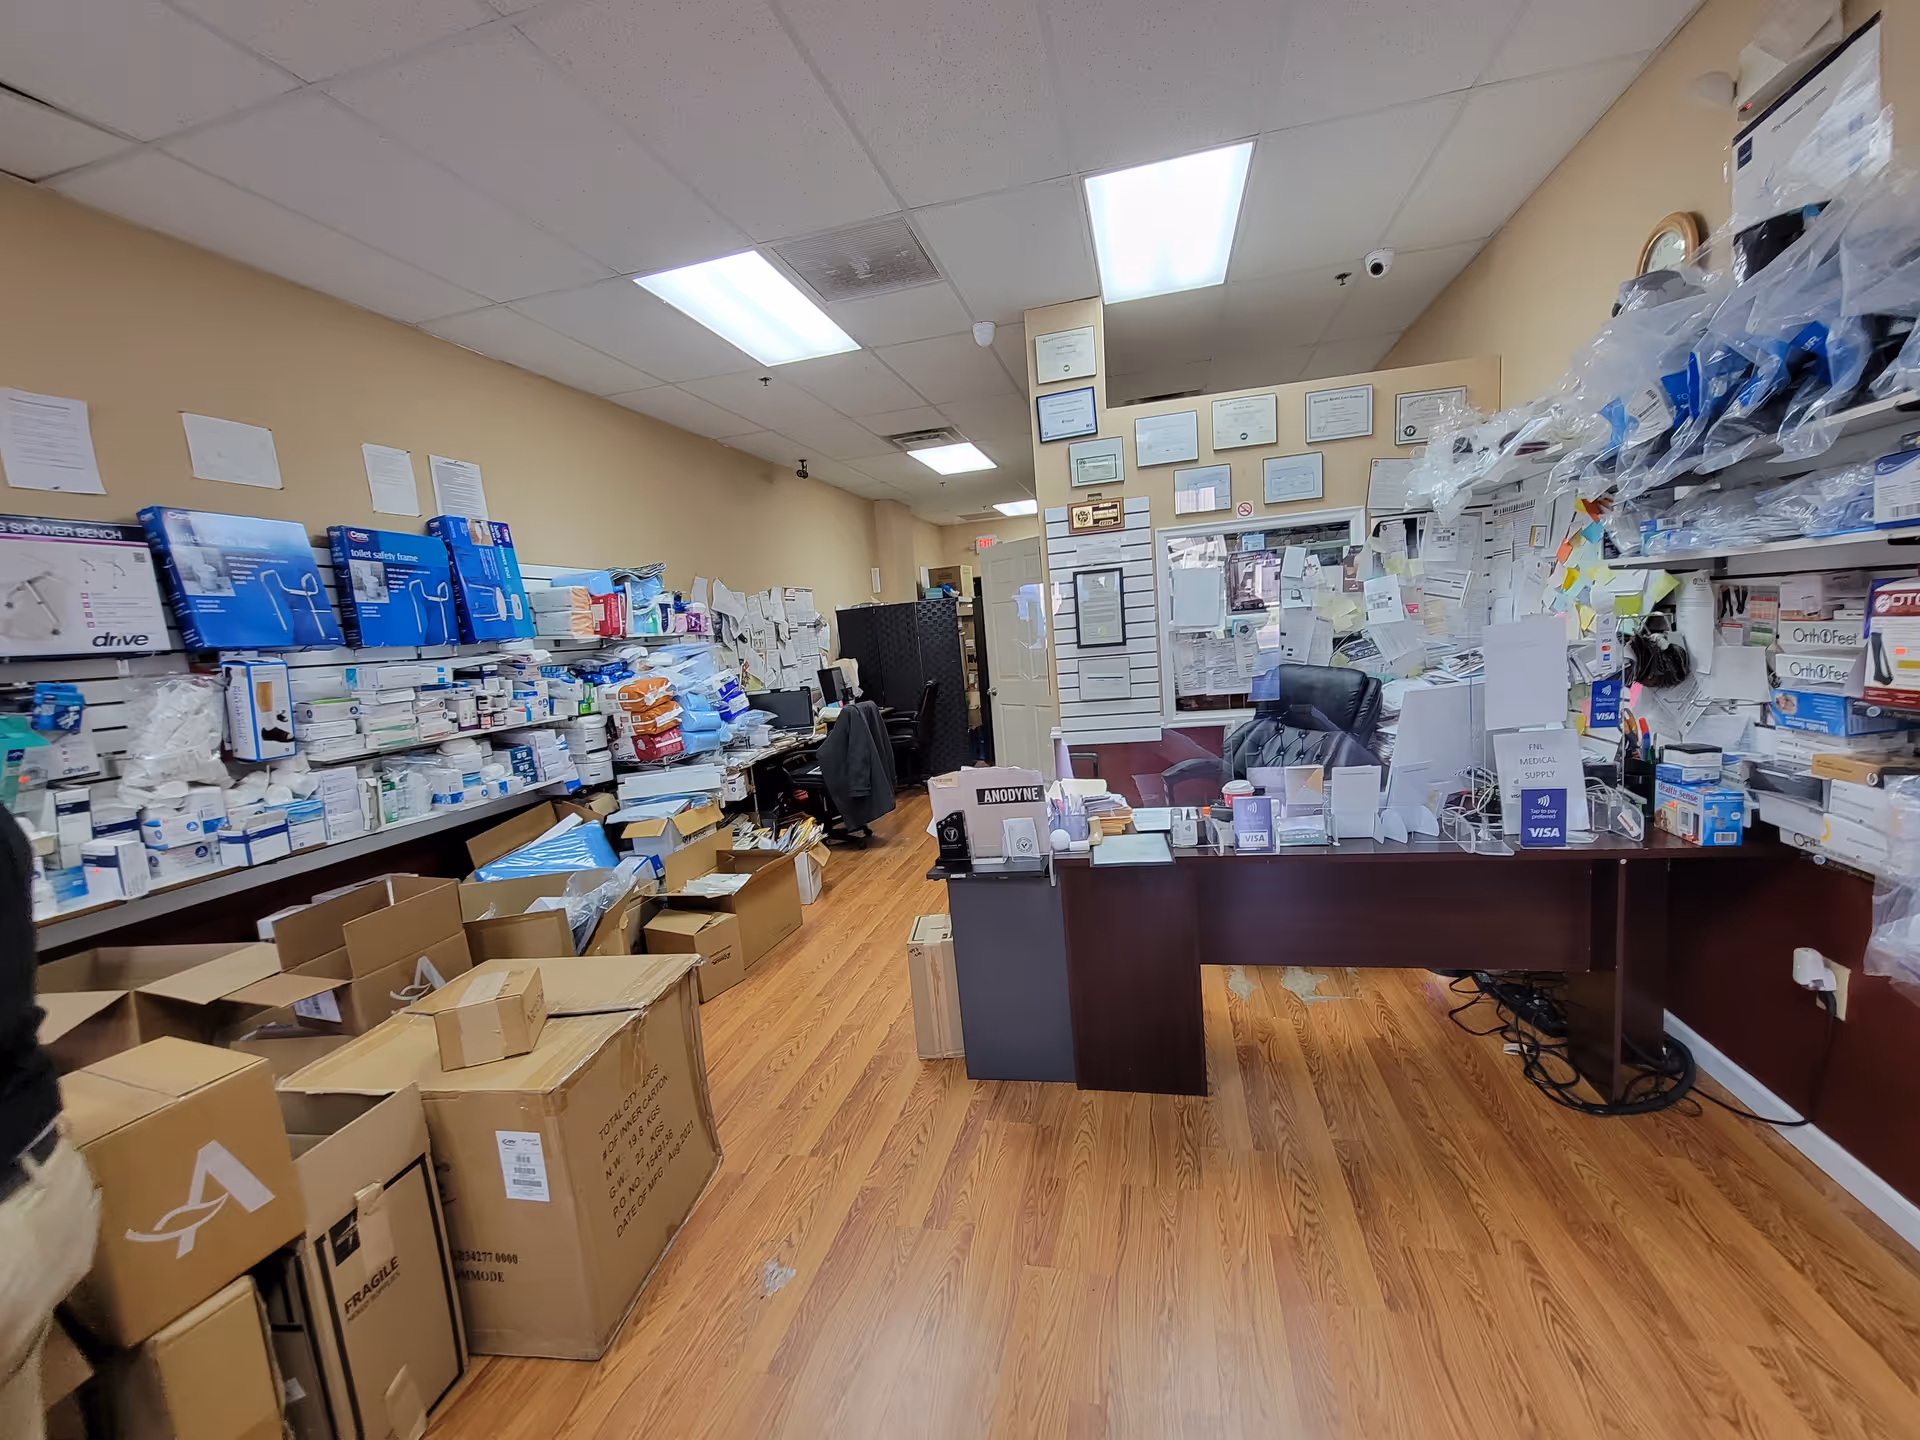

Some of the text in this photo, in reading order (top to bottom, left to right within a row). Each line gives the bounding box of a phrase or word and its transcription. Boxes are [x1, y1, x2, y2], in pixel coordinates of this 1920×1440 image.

[10, 523, 76, 537] SHOWER
[75, 527, 122, 540] BENCH
[978, 538, 993, 548] EXIT
[350, 549, 419, 563] toilet safety frame
[92, 631, 149, 647] drive
[1594, 712, 1616, 721] VISA
[1528, 743, 1545, 751] FNL
[1519, 756, 1557, 766] MEDICAL
[1524, 770, 1556, 780] SUPPLY
[984, 787, 1040, 803] ANODYNE
[1658, 782, 1678, 796] Health
[1679, 790, 1698, 803] Sense
[1244, 834, 1265, 842] VISA
[1528, 827, 1560, 838] VISA
[647, 1104, 661, 1127] KGS
[599, 1109, 623, 1141] TOTAL
[607, 1134, 619, 1154] OF
[620, 1105, 643, 1139] INNER
[635, 1147, 645, 1166] 22
[650, 1120, 665, 1144] KGS
[617, 1203, 638, 1238] DATE
[637, 1187, 648, 1207] OF
[648, 1166, 664, 1193] MFG
[494, 1252, 519, 1265] 0000
[344, 1255, 400, 1315] FRAGILE
